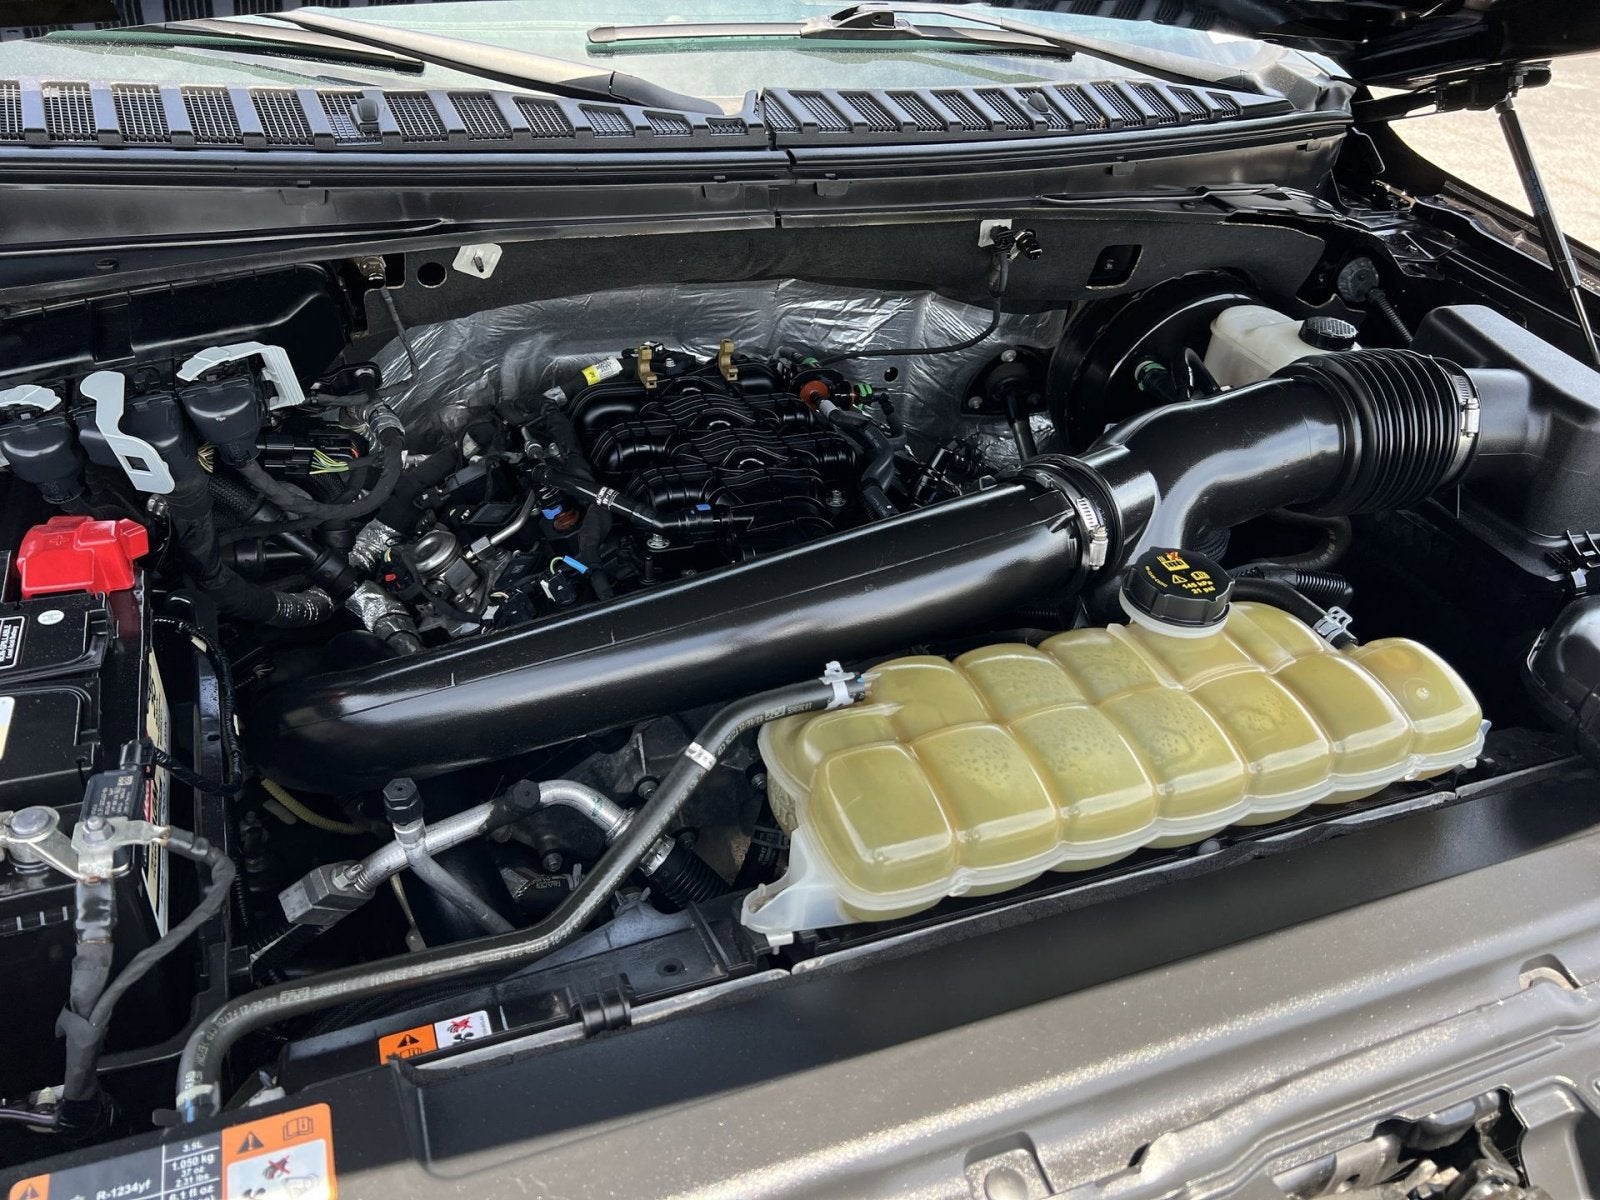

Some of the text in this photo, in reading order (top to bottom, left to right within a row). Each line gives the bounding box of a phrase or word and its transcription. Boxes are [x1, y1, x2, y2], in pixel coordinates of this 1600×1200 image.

[182, 1140, 203, 1152] 3.5L
[172, 1153, 215, 1171] 1.050 kg
[96, 1178, 151, 1200] R-1234yf
